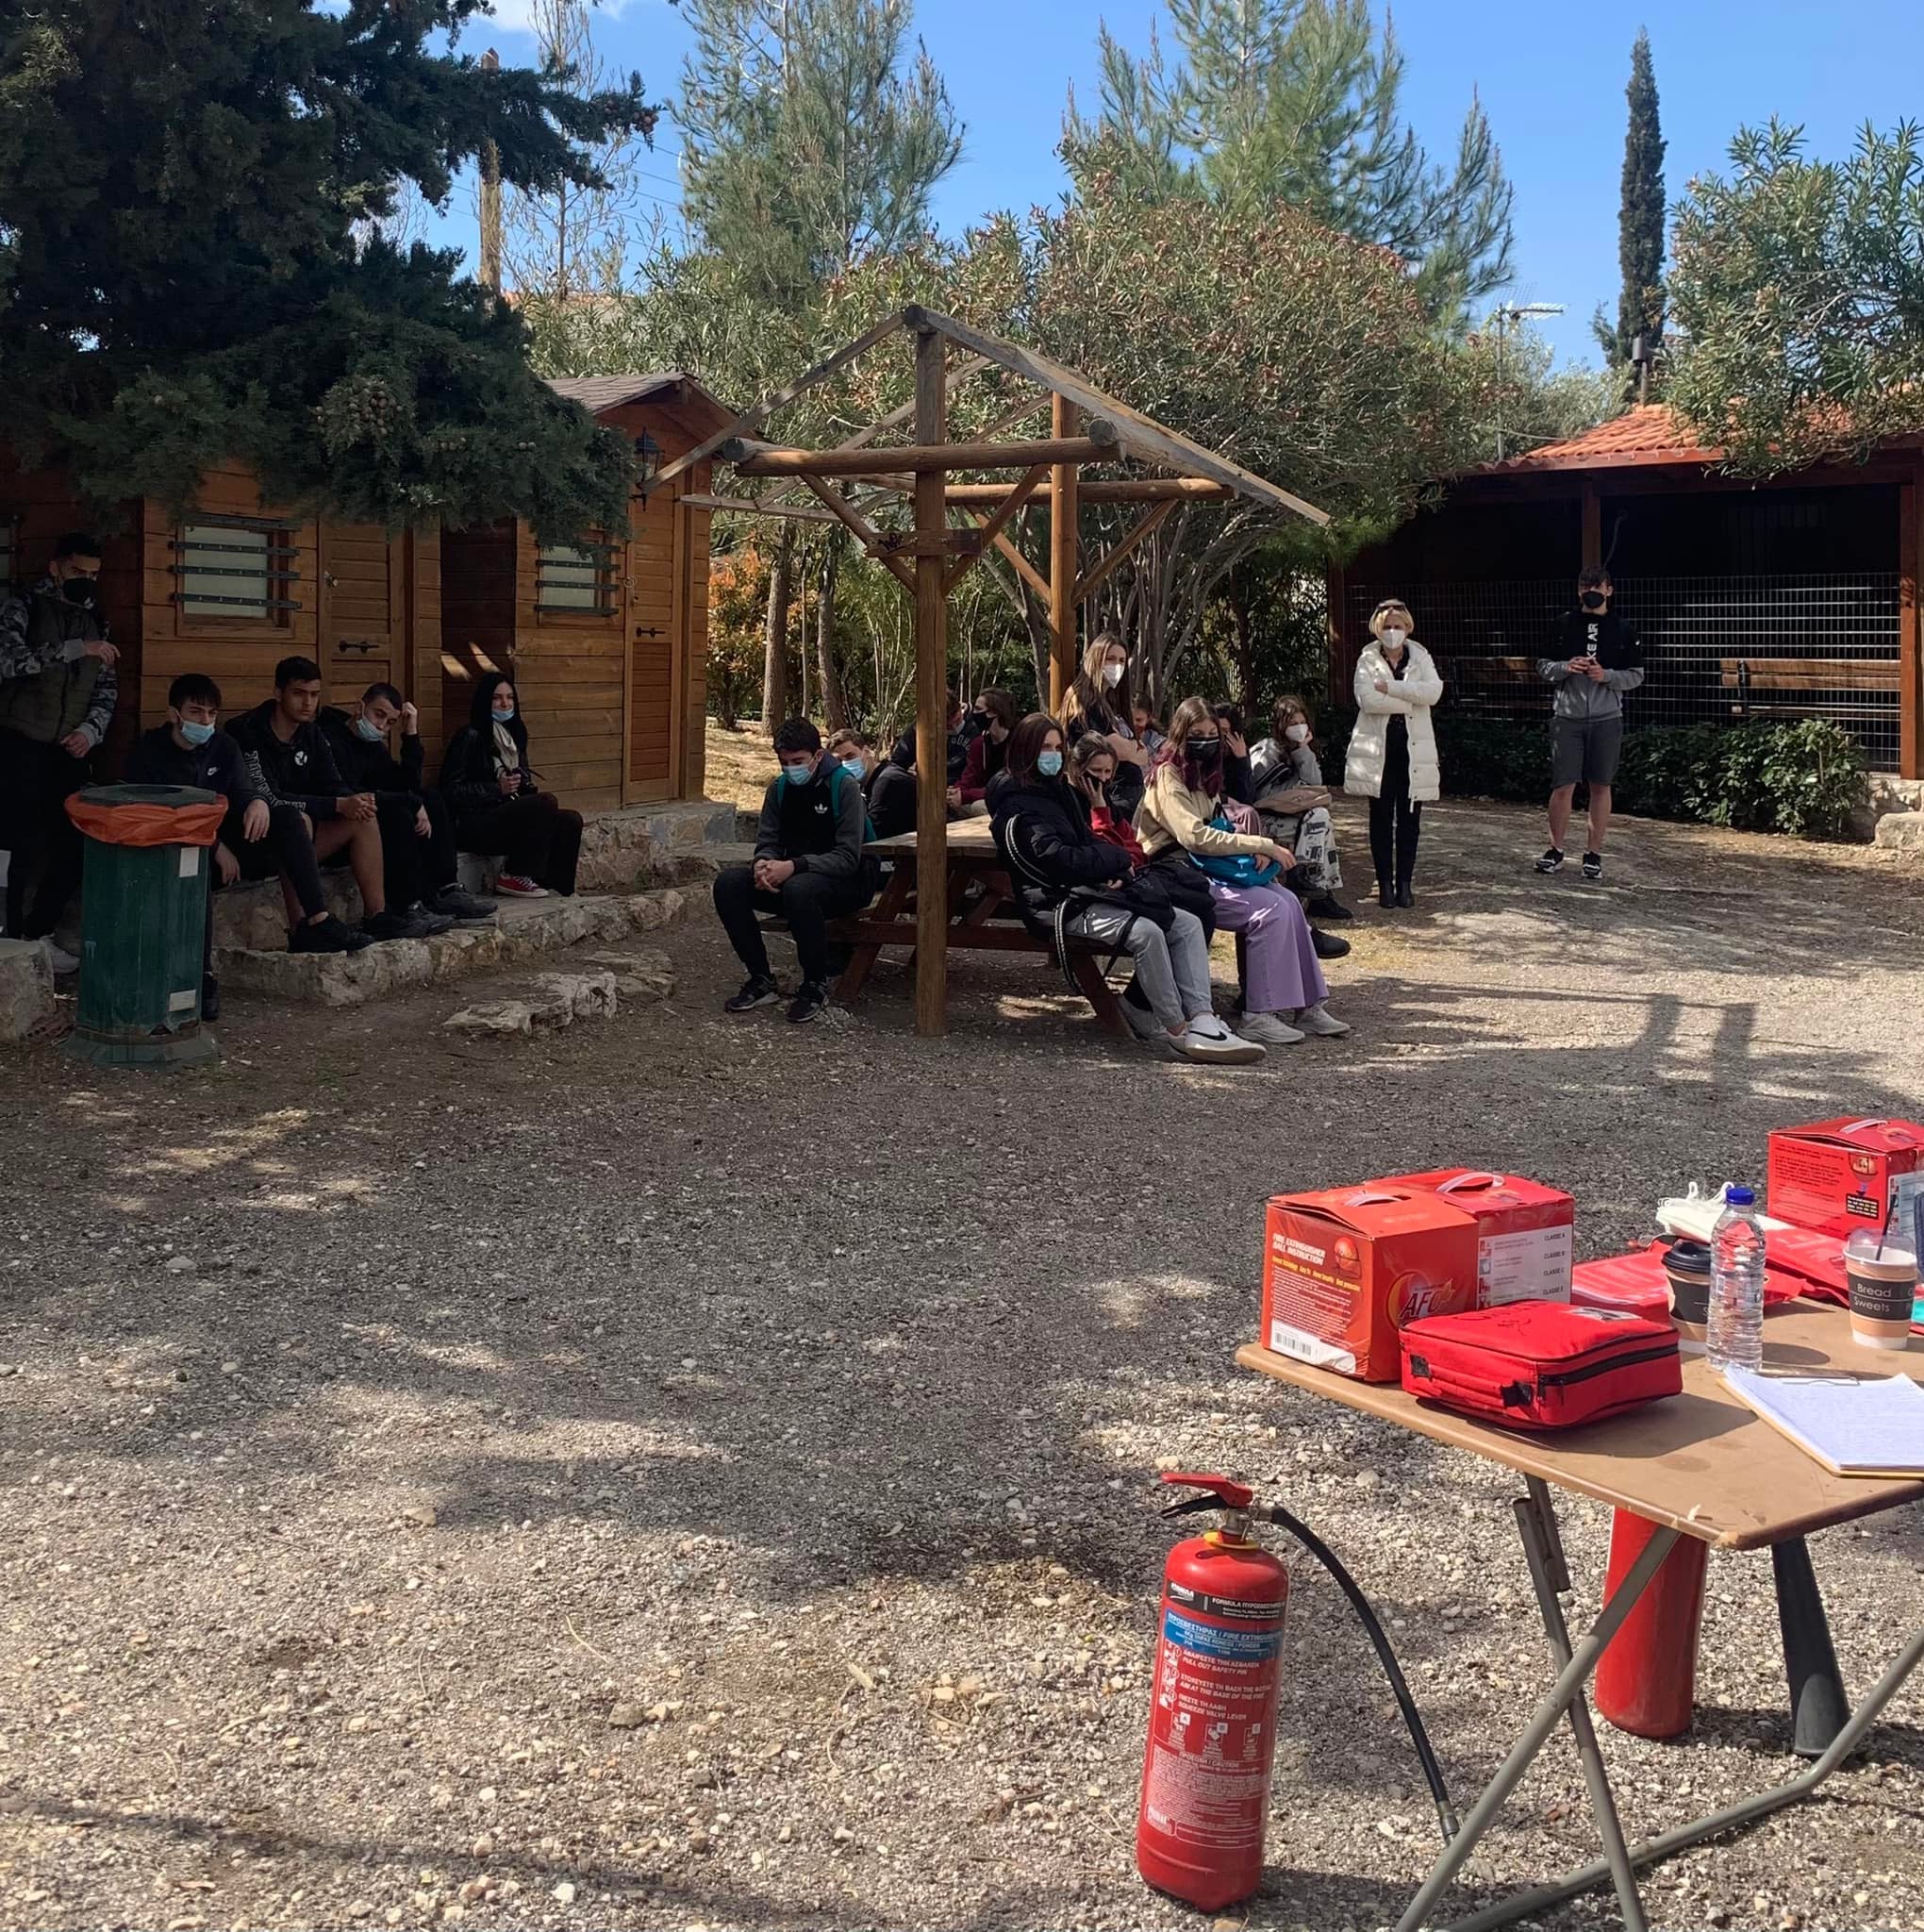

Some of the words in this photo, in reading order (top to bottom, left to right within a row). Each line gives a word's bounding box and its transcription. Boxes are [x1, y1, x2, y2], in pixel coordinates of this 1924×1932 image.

[1587, 623, 1599, 641] AIR
[1856, 1282, 1892, 1298] Bread
[1853, 1295, 1890, 1312] Sweets
[1212, 1597, 1241, 1608] FORMULA
[1222, 1631, 1239, 1640] FIRE
[1183, 1657, 1197, 1668] PULL
[1197, 1661, 1211, 1670] OUT
[1211, 1665, 1236, 1675] SAFETY
[1180, 1680, 1191, 1690] AIM
[1199, 1687, 1212, 1695] THE
[1206, 1708, 1226, 1718] VALVE
[1212, 1758, 1239, 1768] CAUTION
